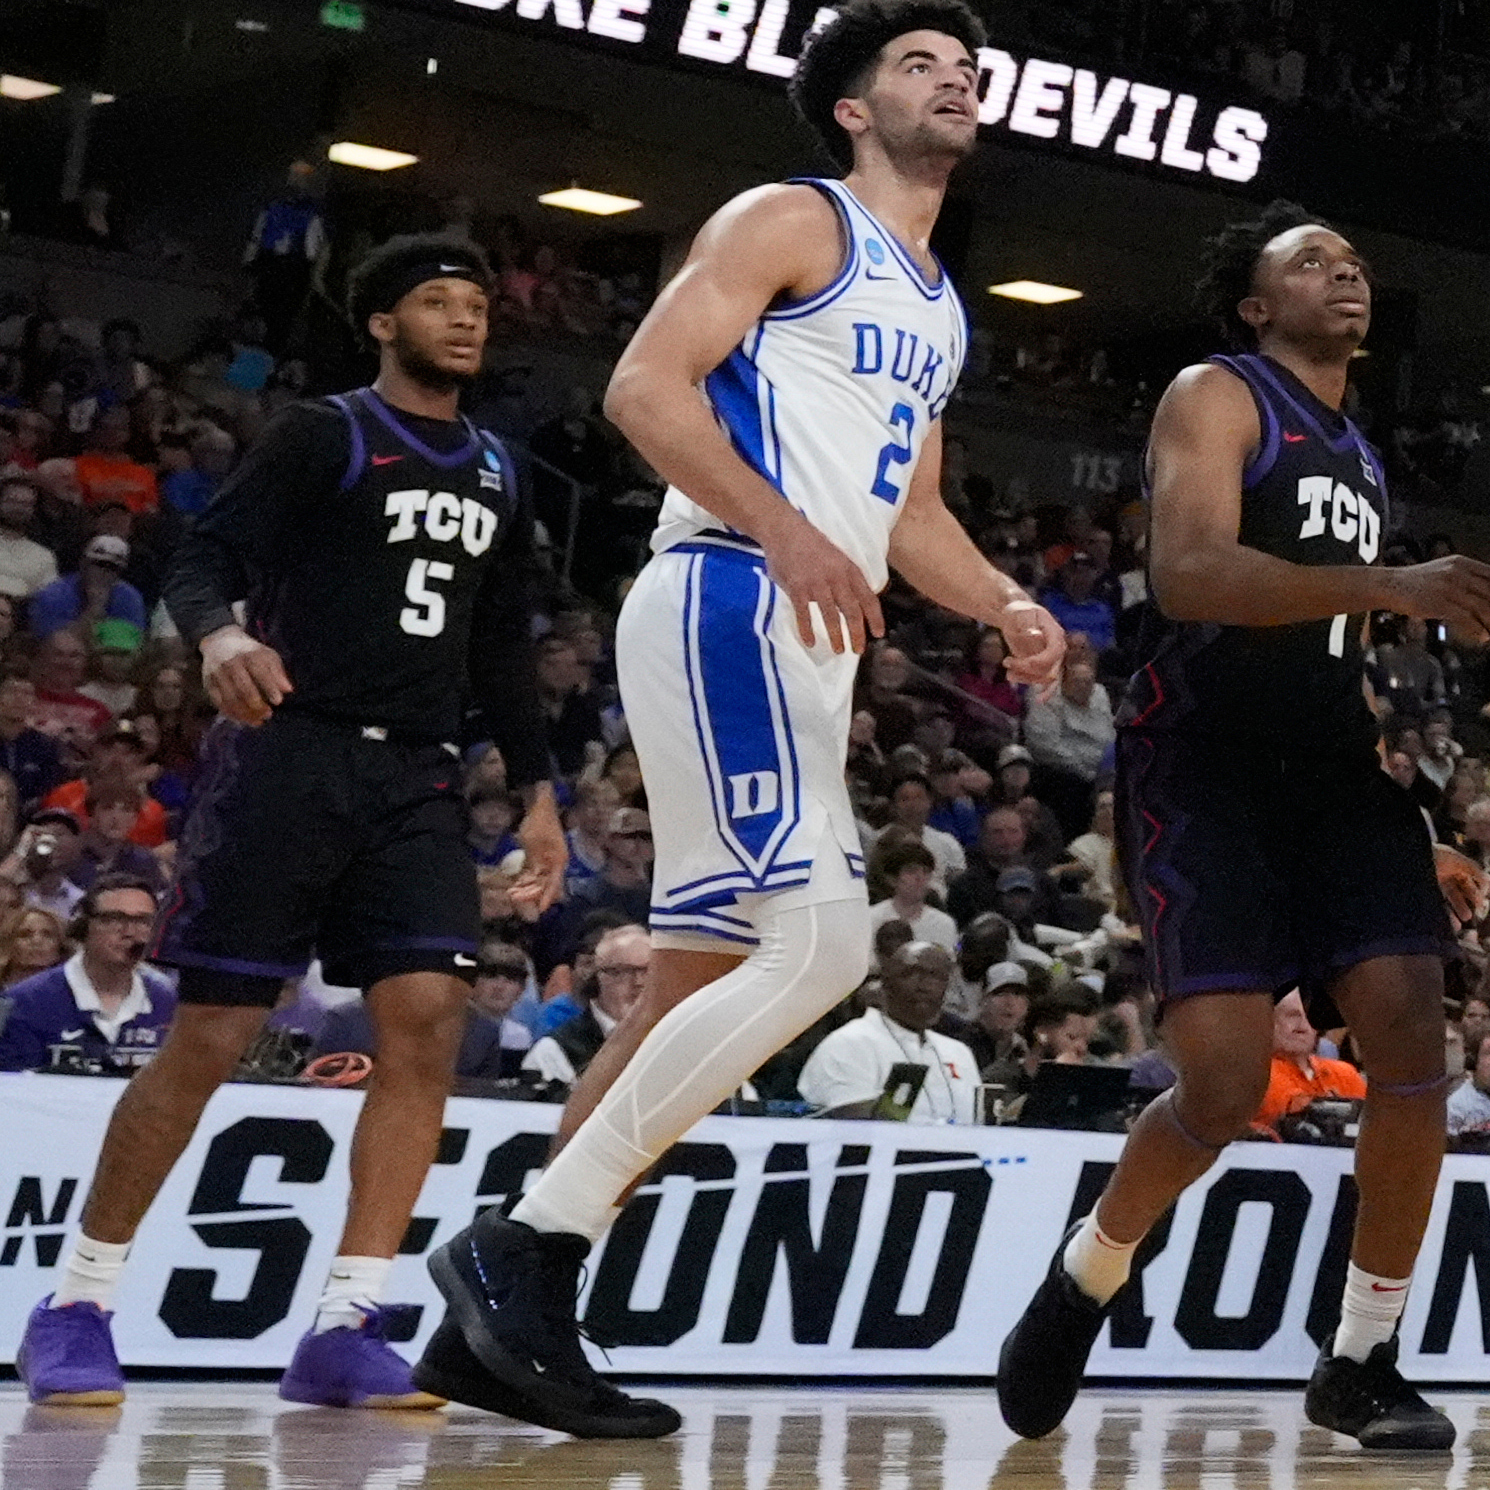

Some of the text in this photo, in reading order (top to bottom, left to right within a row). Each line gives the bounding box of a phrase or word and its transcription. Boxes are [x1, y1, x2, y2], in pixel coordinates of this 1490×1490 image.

[976, 46, 1269, 183] DEVILS
[852, 323, 952, 424] DUKE
[870, 401, 915, 506] 2
[384, 489, 498, 557] TCU
[1297, 475, 1381, 564] TCU
[400, 558, 454, 638] 5
[728, 770, 778, 819] D
[0, 1176, 80, 1268] N
